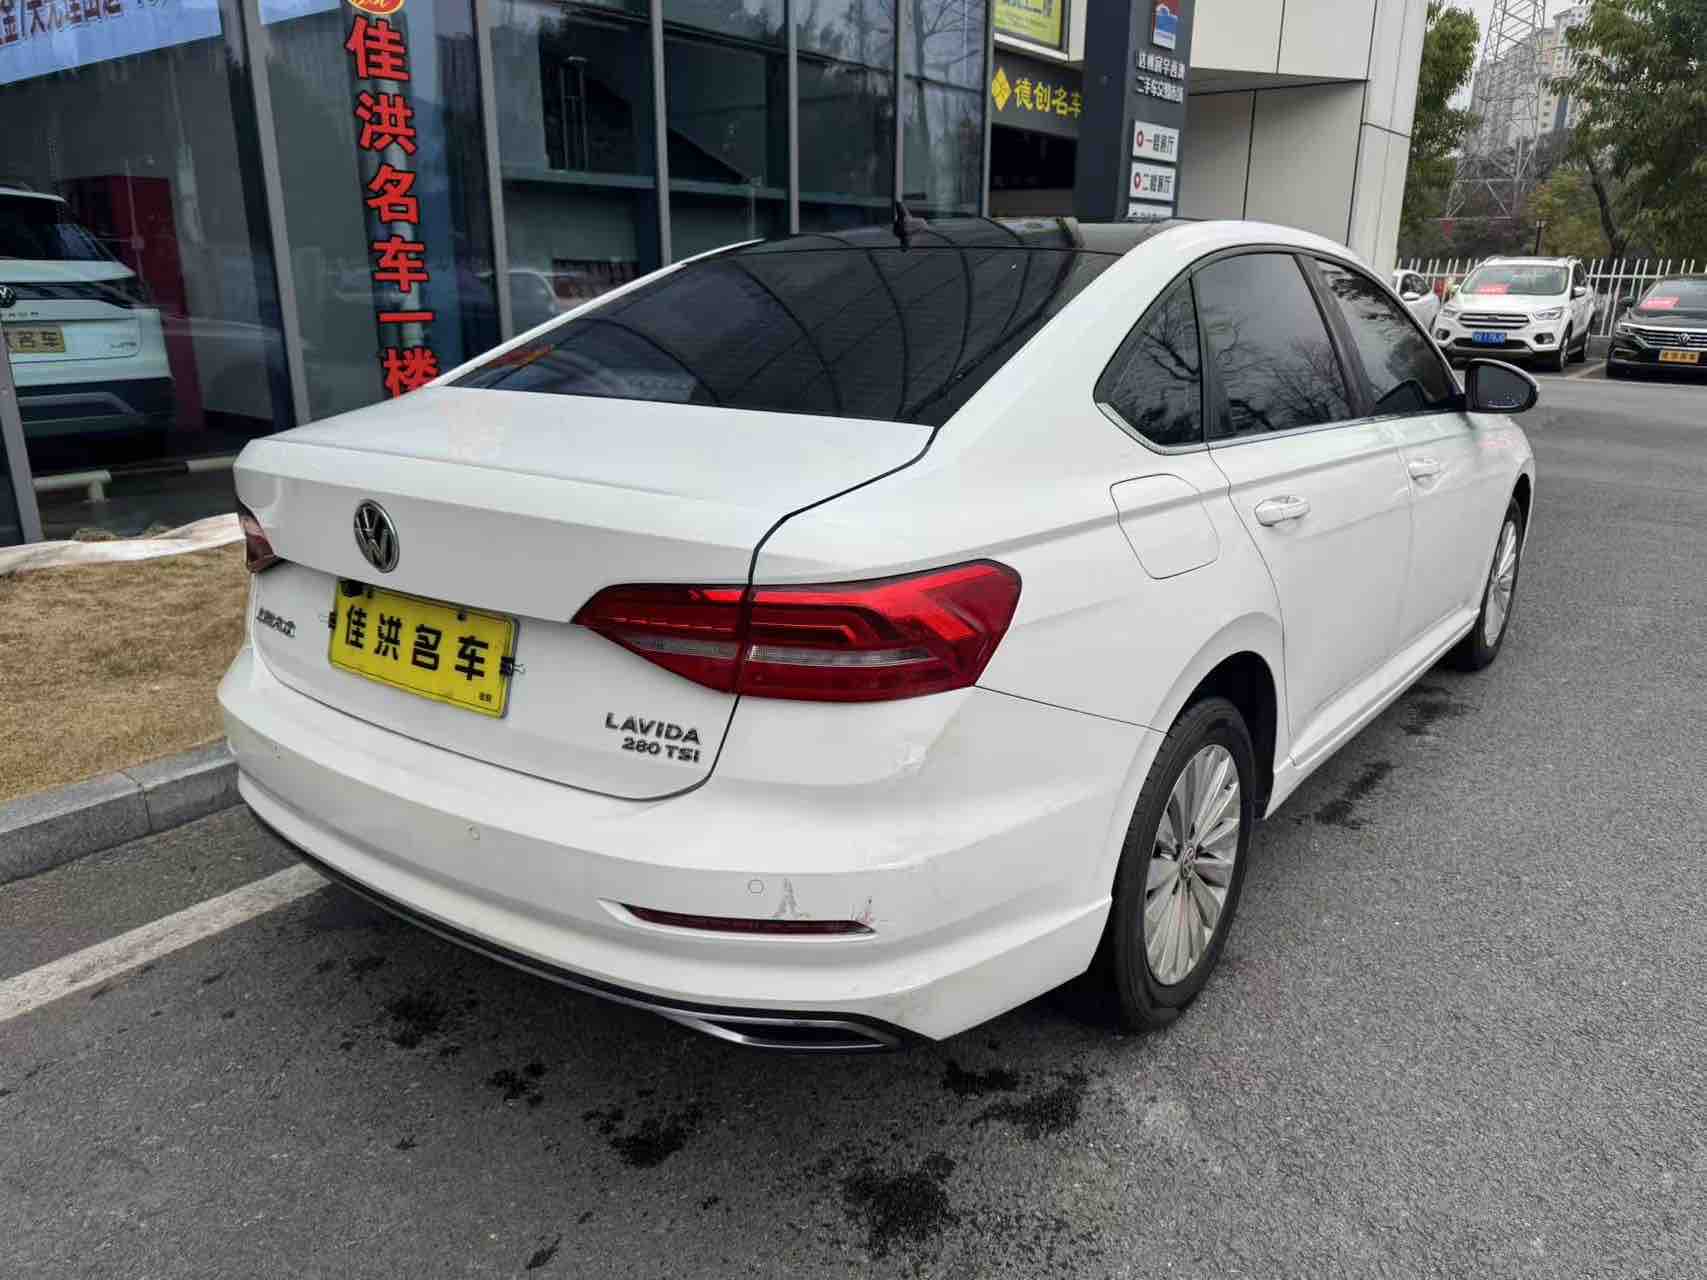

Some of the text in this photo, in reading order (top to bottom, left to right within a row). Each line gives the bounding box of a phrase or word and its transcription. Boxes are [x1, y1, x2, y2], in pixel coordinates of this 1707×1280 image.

[1014, 78, 1082, 119] 德创名车
[345, 15, 440, 400] 佳洪名车一楼
[344, 604, 489, 681] 佳洪名车
[605, 712, 700, 745] LAVIDA
[622, 737, 700, 763] 280 TSI
